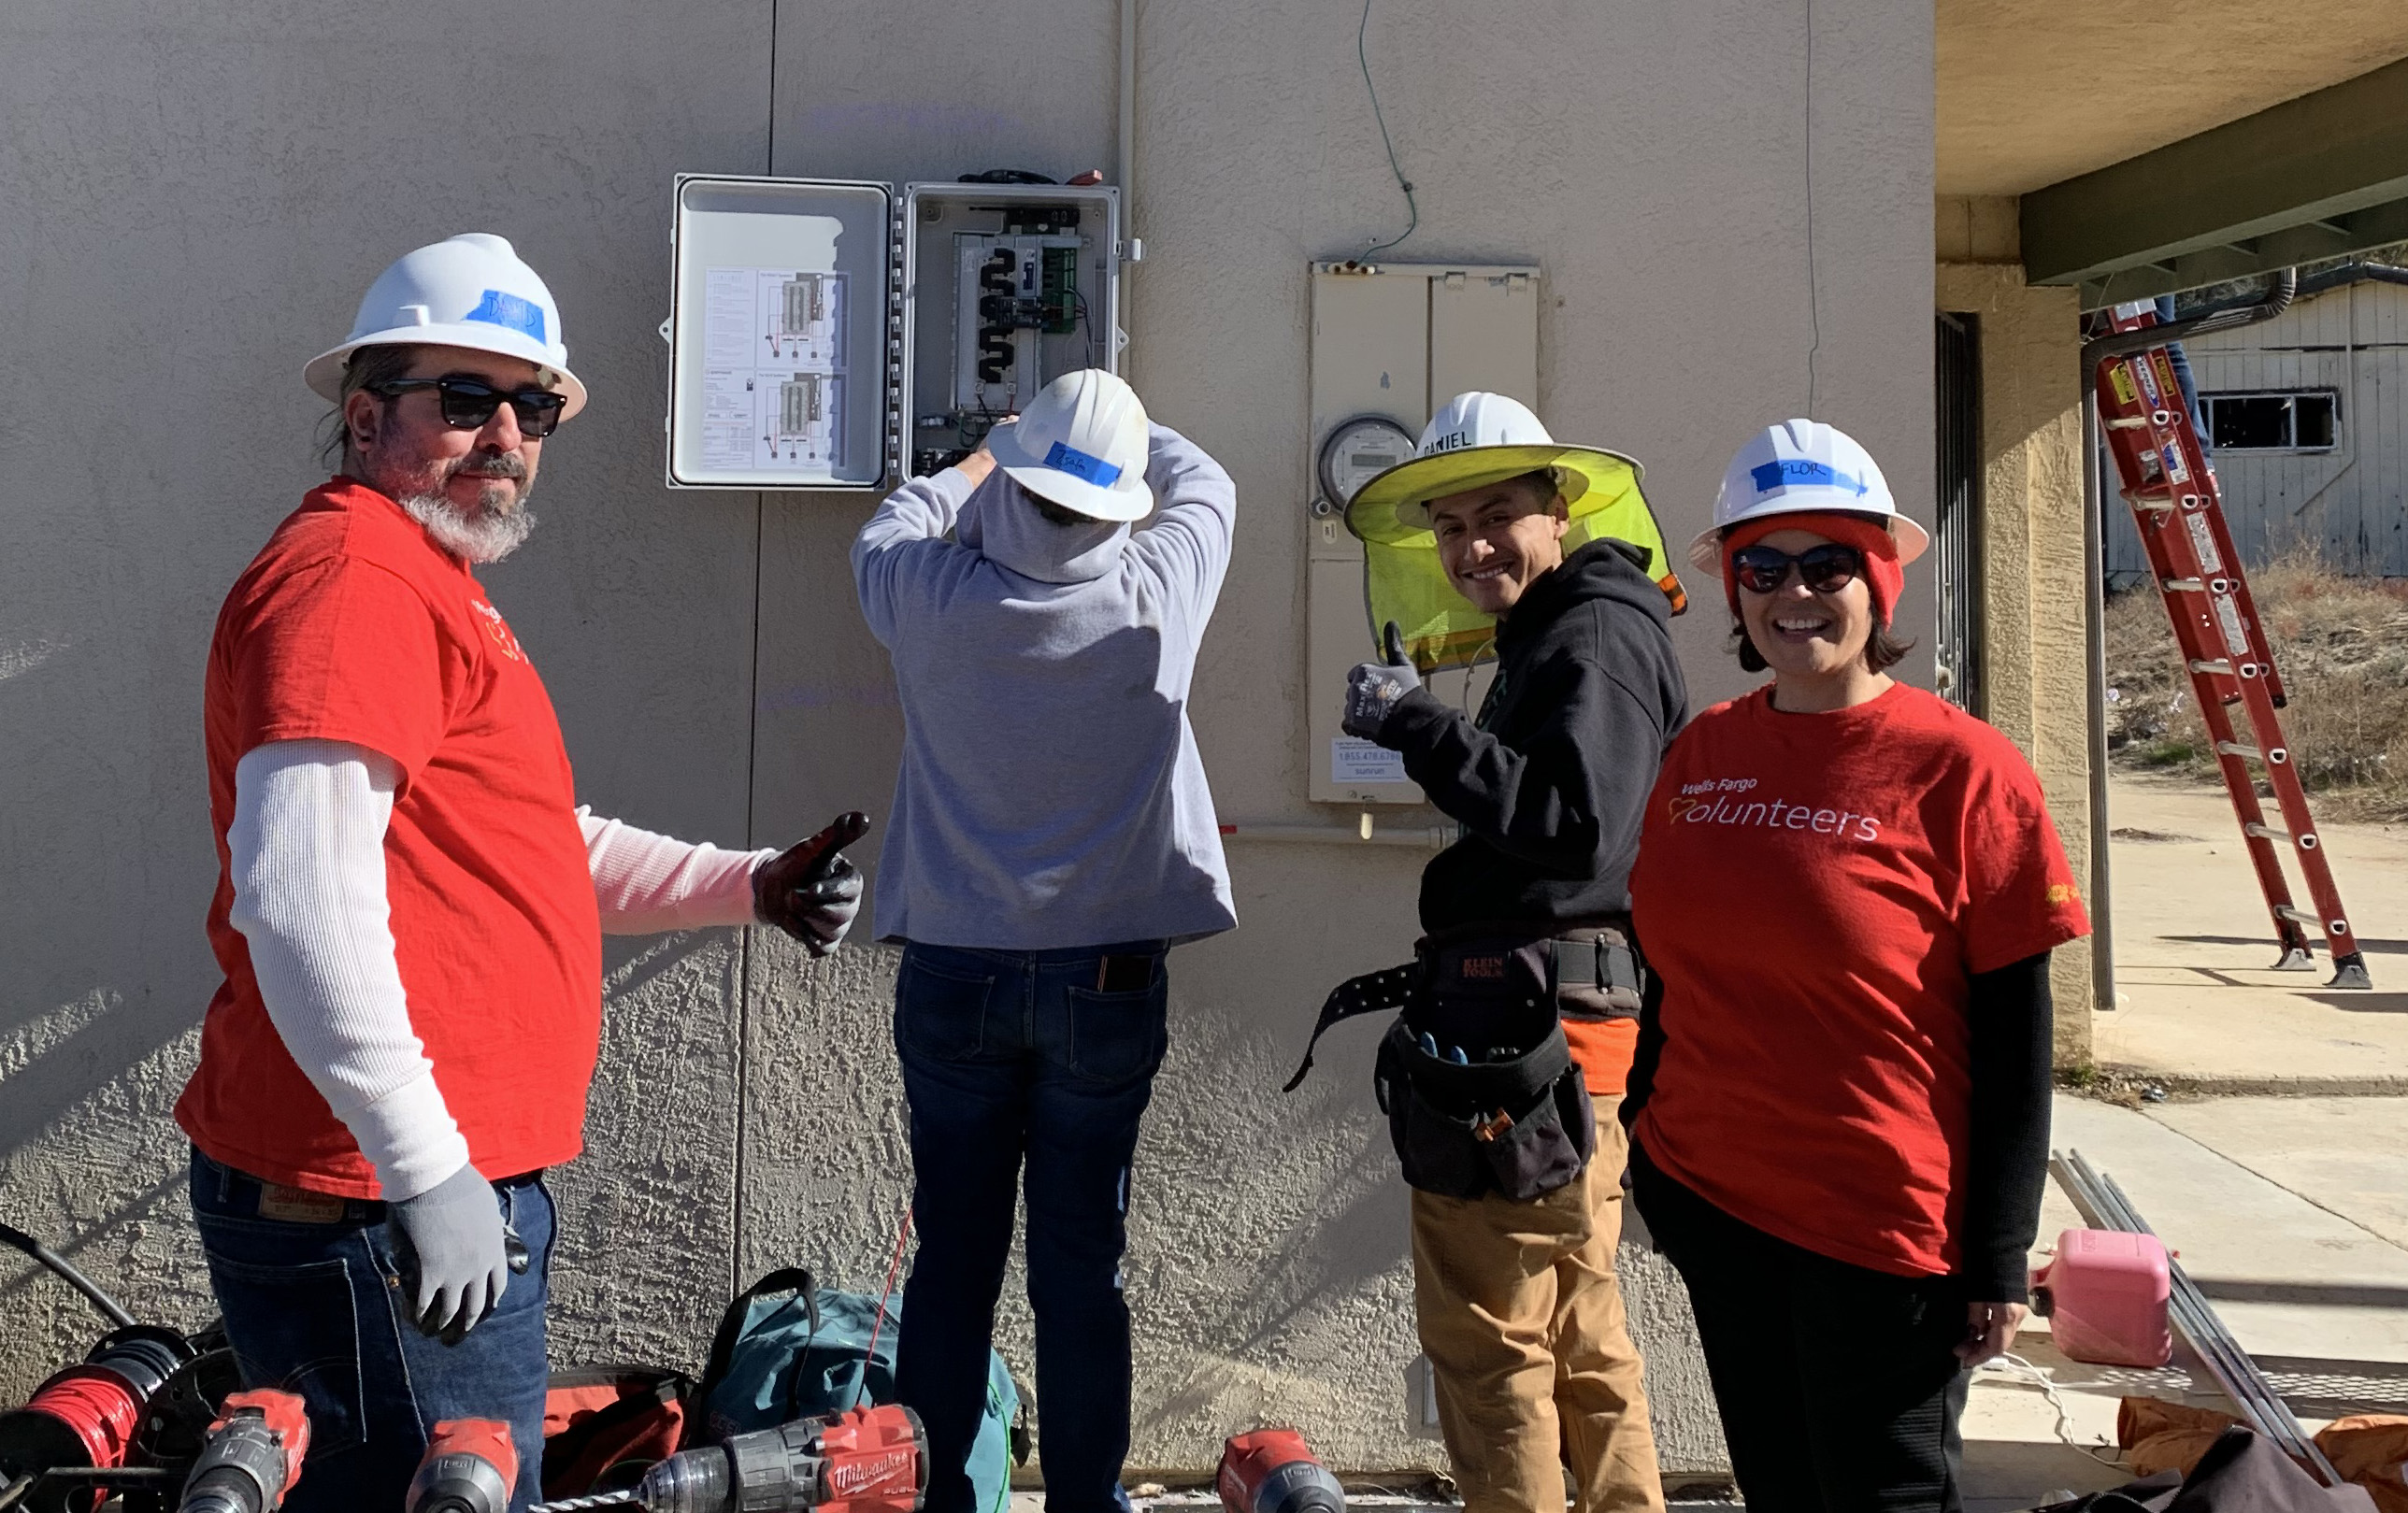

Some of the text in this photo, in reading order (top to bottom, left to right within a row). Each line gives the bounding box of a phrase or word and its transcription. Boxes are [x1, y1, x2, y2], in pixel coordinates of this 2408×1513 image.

[1424, 431, 1472, 456] DANIEL
[1780, 462, 1827, 476] FLOR
[1682, 778, 1758, 794] Wells Fargo
[1462, 957, 1503, 967] KLEIN
[834, 1450, 910, 1489] Milwaukee
